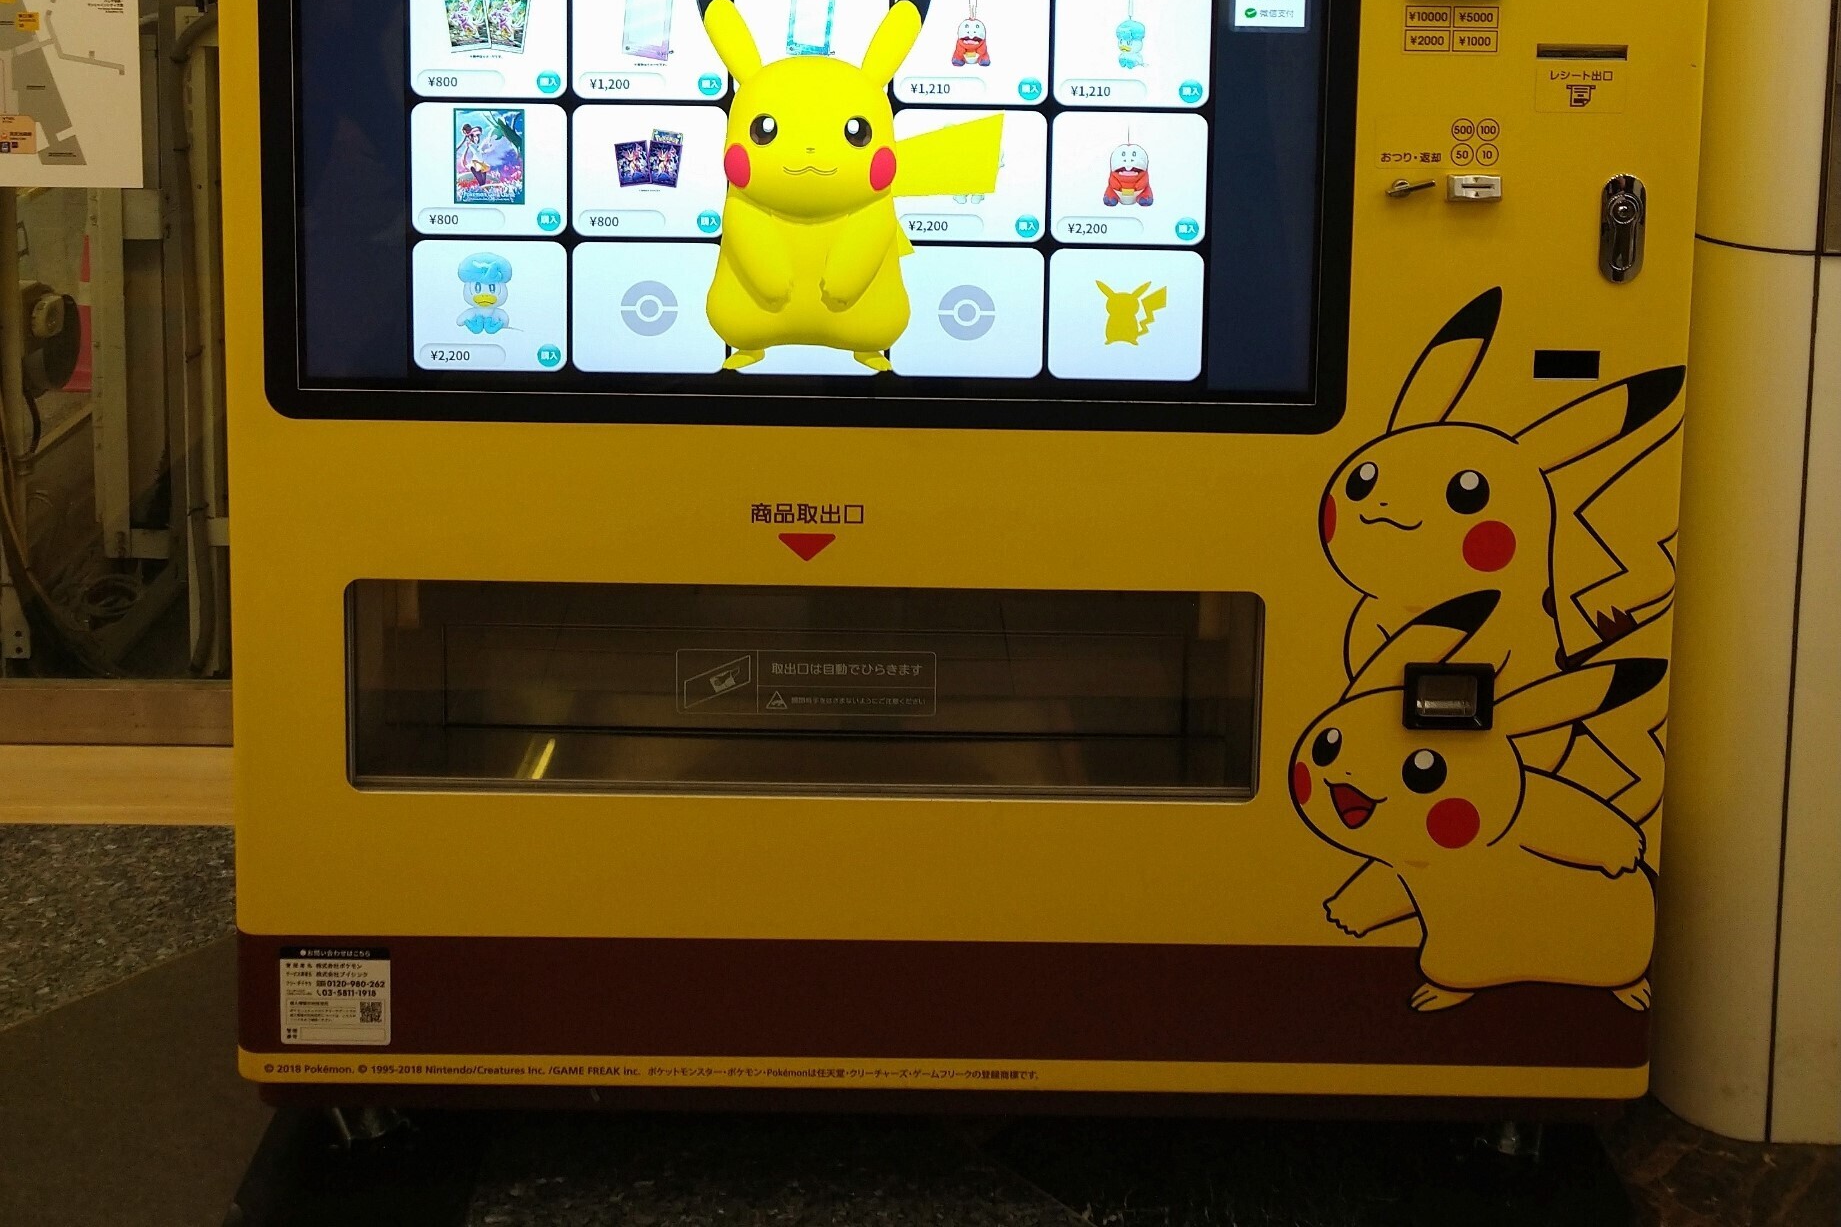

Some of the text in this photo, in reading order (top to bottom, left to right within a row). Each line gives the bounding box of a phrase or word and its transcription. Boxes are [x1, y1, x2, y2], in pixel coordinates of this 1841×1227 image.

[1409, 11, 1494, 23] ¥10000 ¥5000
[1410, 35, 1491, 47] ¥2000 ¥1000
[428, 76, 458, 87] ¥800
[1549, 70, 1613, 82] レシート出口
[590, 78, 630, 91] ¥1,200
[911, 83, 950, 96] ¥1,210
[1071, 85, 1111, 98] ¥1,210
[1454, 125, 1496, 135] 500 100
[1380, 152, 1441, 163] おつり・返却
[1455, 149, 1493, 160] 50 10
[429, 214, 459, 225] ¥800
[590, 216, 619, 227] ¥800
[908, 220, 948, 233] ¥2,200
[1068, 223, 1107, 236] ¥2,200
[431, 350, 470, 363] ¥2,200
[751, 503, 864, 524] 商品取出口
[771, 662, 923, 677] 取出口は自動でひらきます
[277, 1064, 300, 1074] 2018
[371, 1065, 422, 1075] 1995-2018
[425, 1065, 525, 1076] Nintendo/Creatures
[587, 1066, 620, 1076] FREAK
